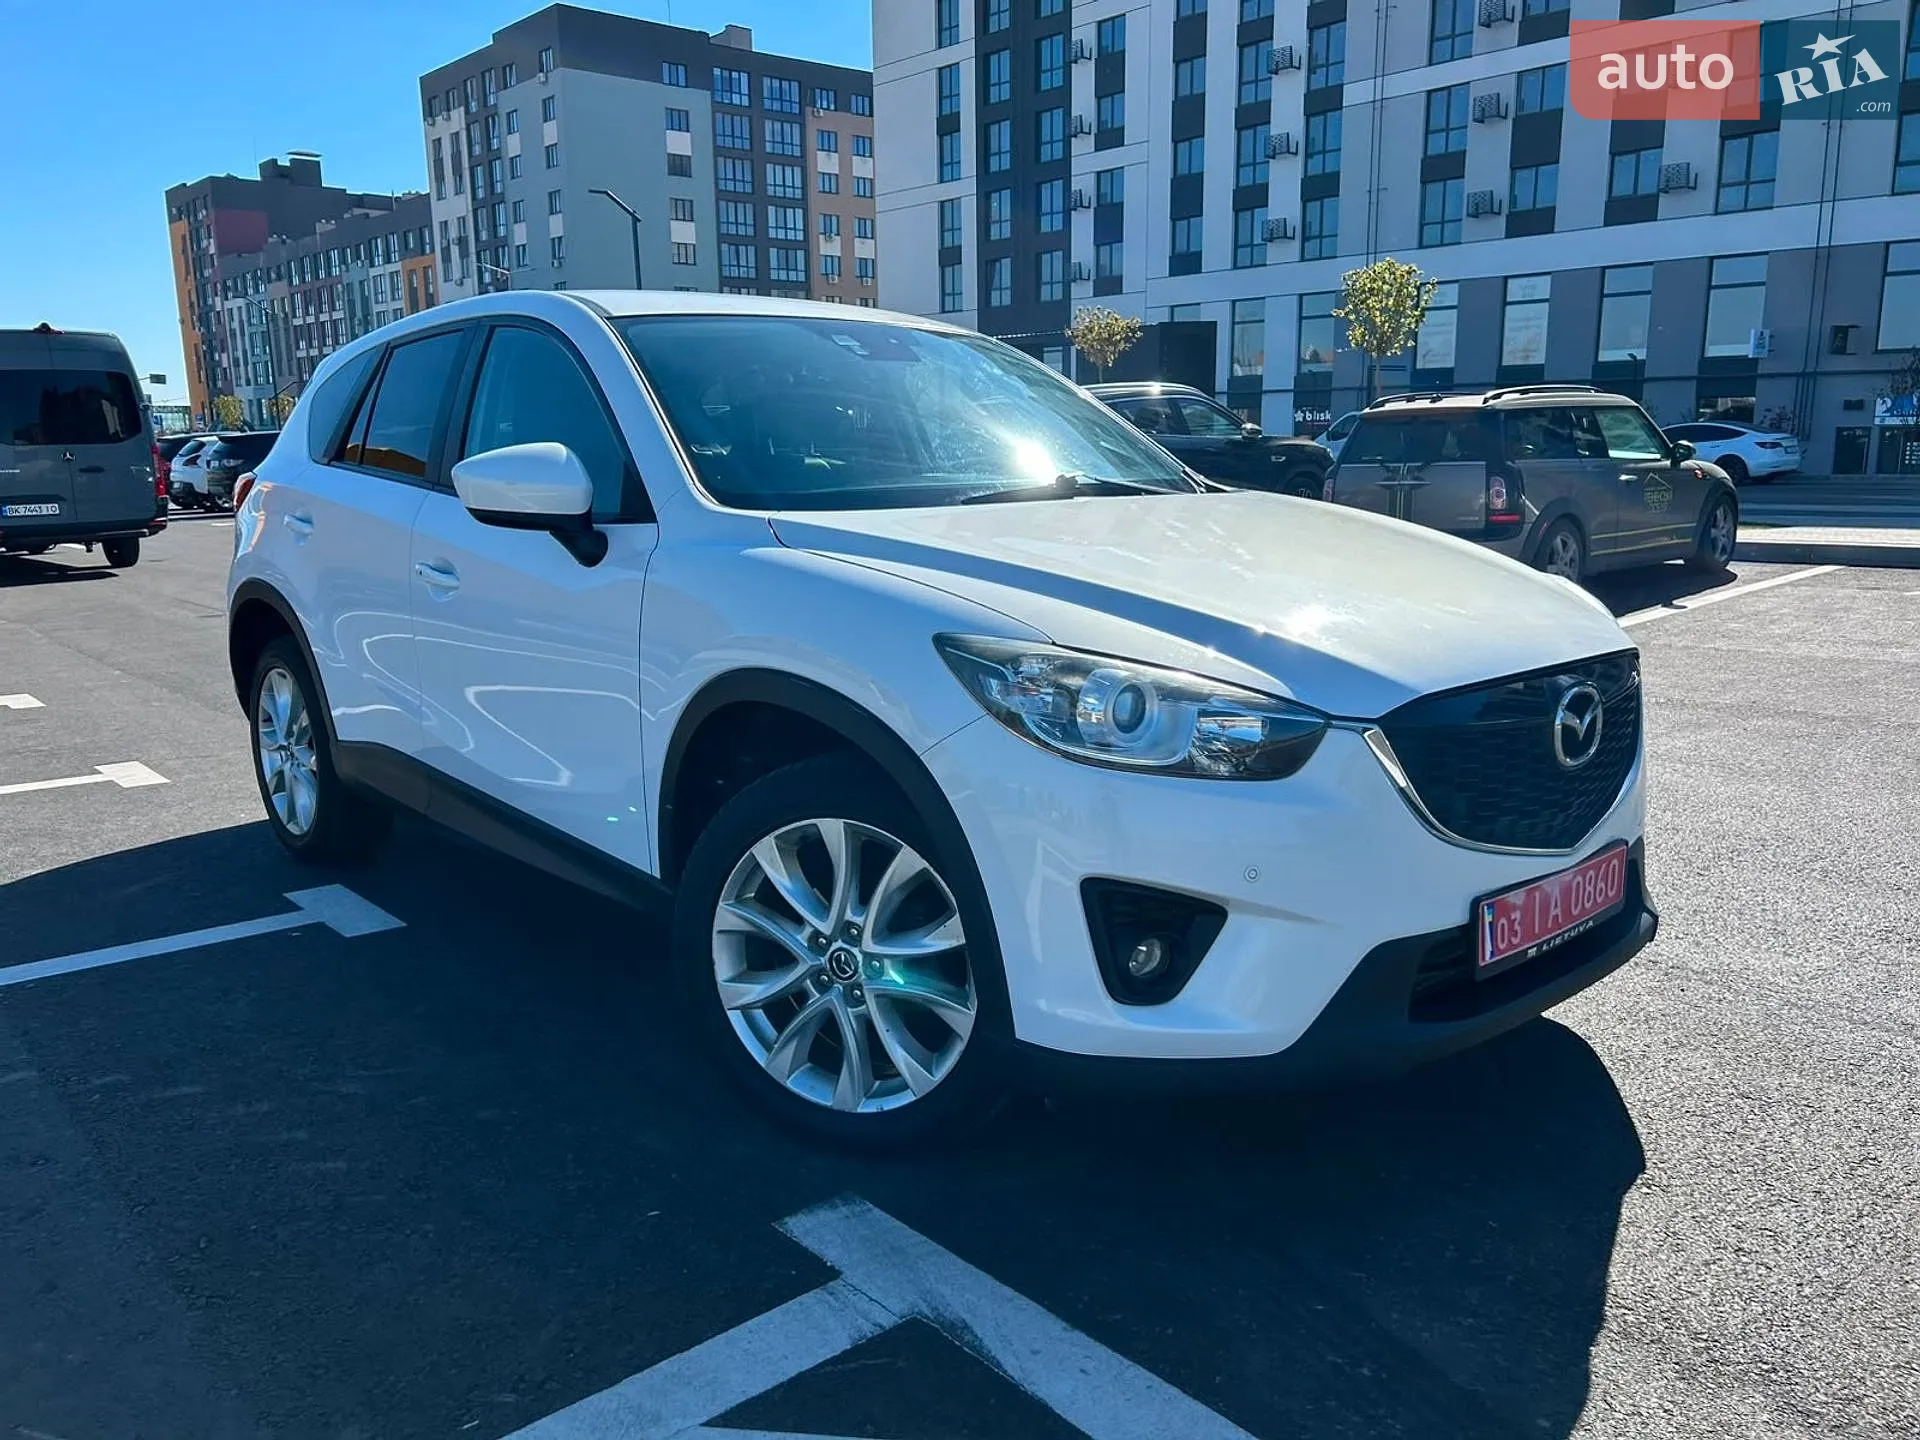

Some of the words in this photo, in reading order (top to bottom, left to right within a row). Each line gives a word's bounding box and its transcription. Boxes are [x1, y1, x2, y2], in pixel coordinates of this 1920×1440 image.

[1305, 409, 1332, 421] blisk
[1497, 909, 1522, 950] 03
[1570, 859, 1619, 916] 0860
[1542, 919, 1594, 951] LIETUVA
